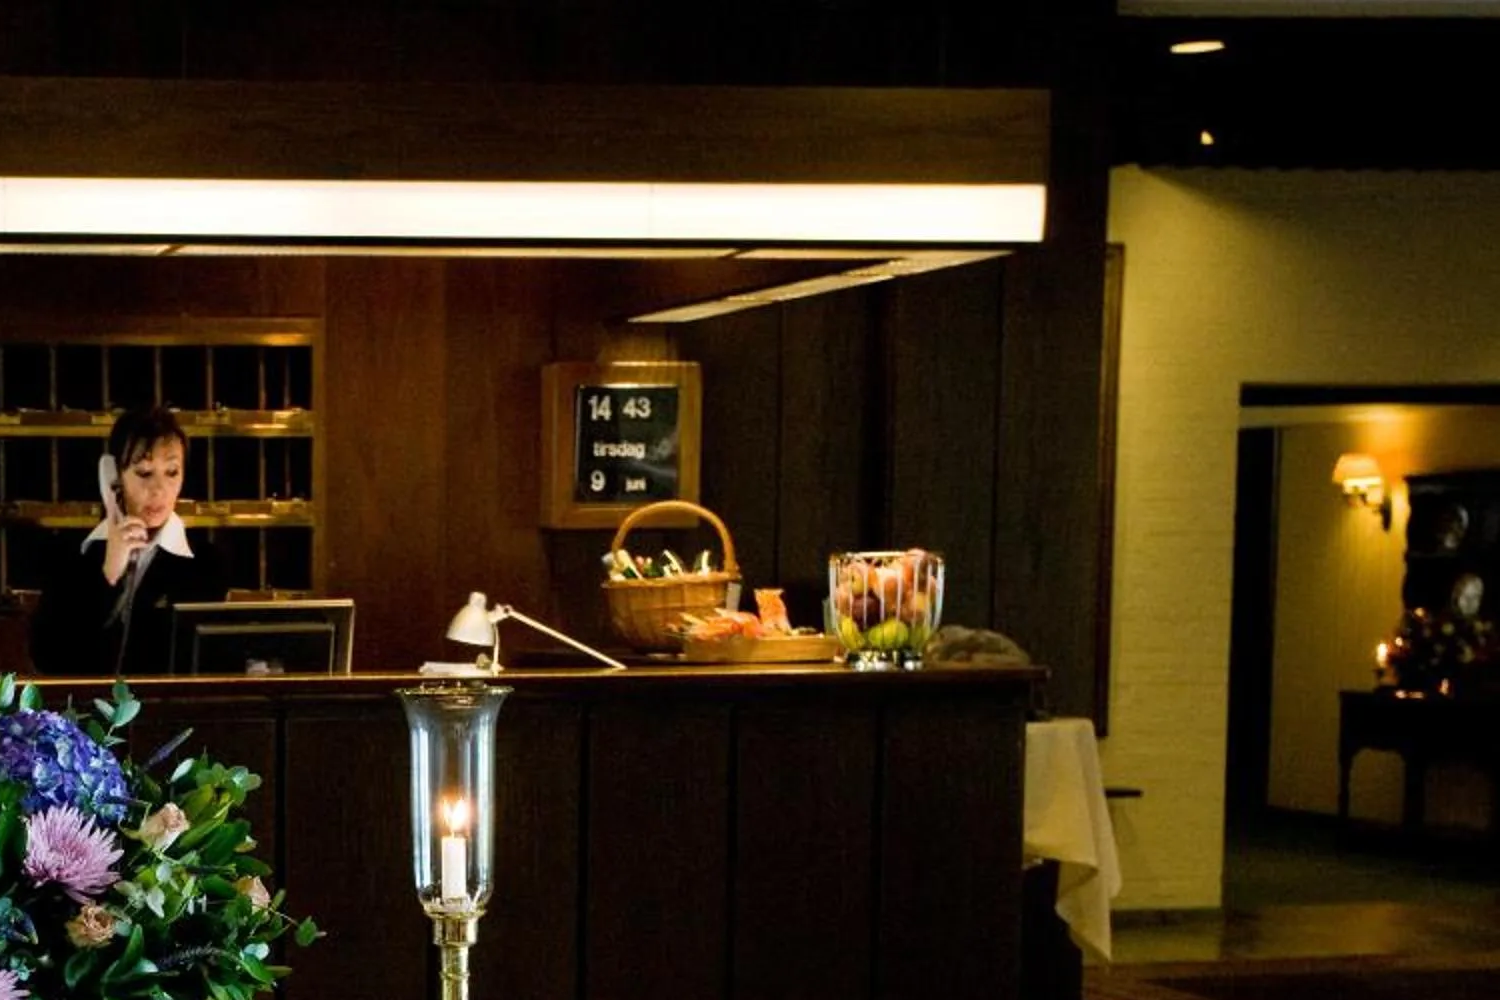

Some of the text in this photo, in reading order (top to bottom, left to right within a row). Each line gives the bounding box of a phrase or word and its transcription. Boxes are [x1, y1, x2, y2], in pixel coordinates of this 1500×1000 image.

[588, 395, 652, 421] 14 43
[590, 469, 606, 492] 9
